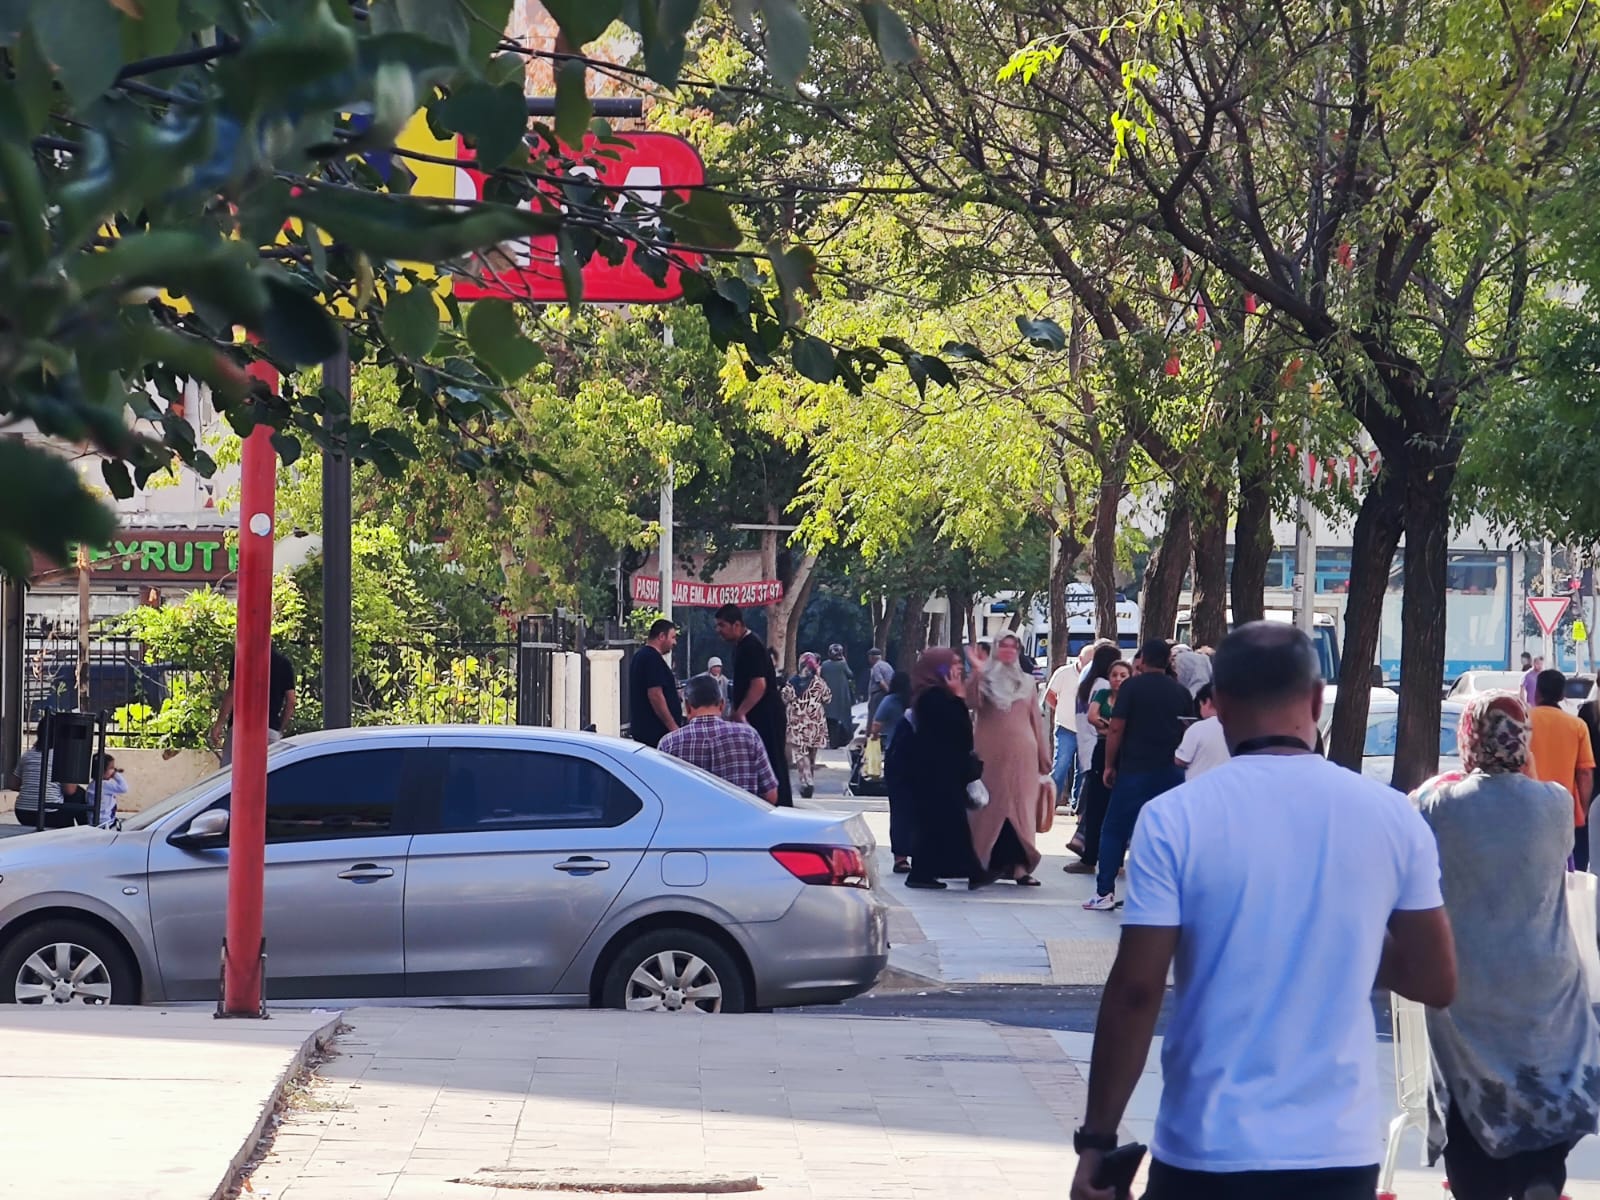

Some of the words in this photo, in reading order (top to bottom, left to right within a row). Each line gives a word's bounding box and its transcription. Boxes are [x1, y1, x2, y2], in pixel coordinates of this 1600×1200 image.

[720, 587, 739, 604] 0532
[741, 585, 756, 603] 245
[758, 584, 768, 602] 37
[769, 583, 780, 600] 97
